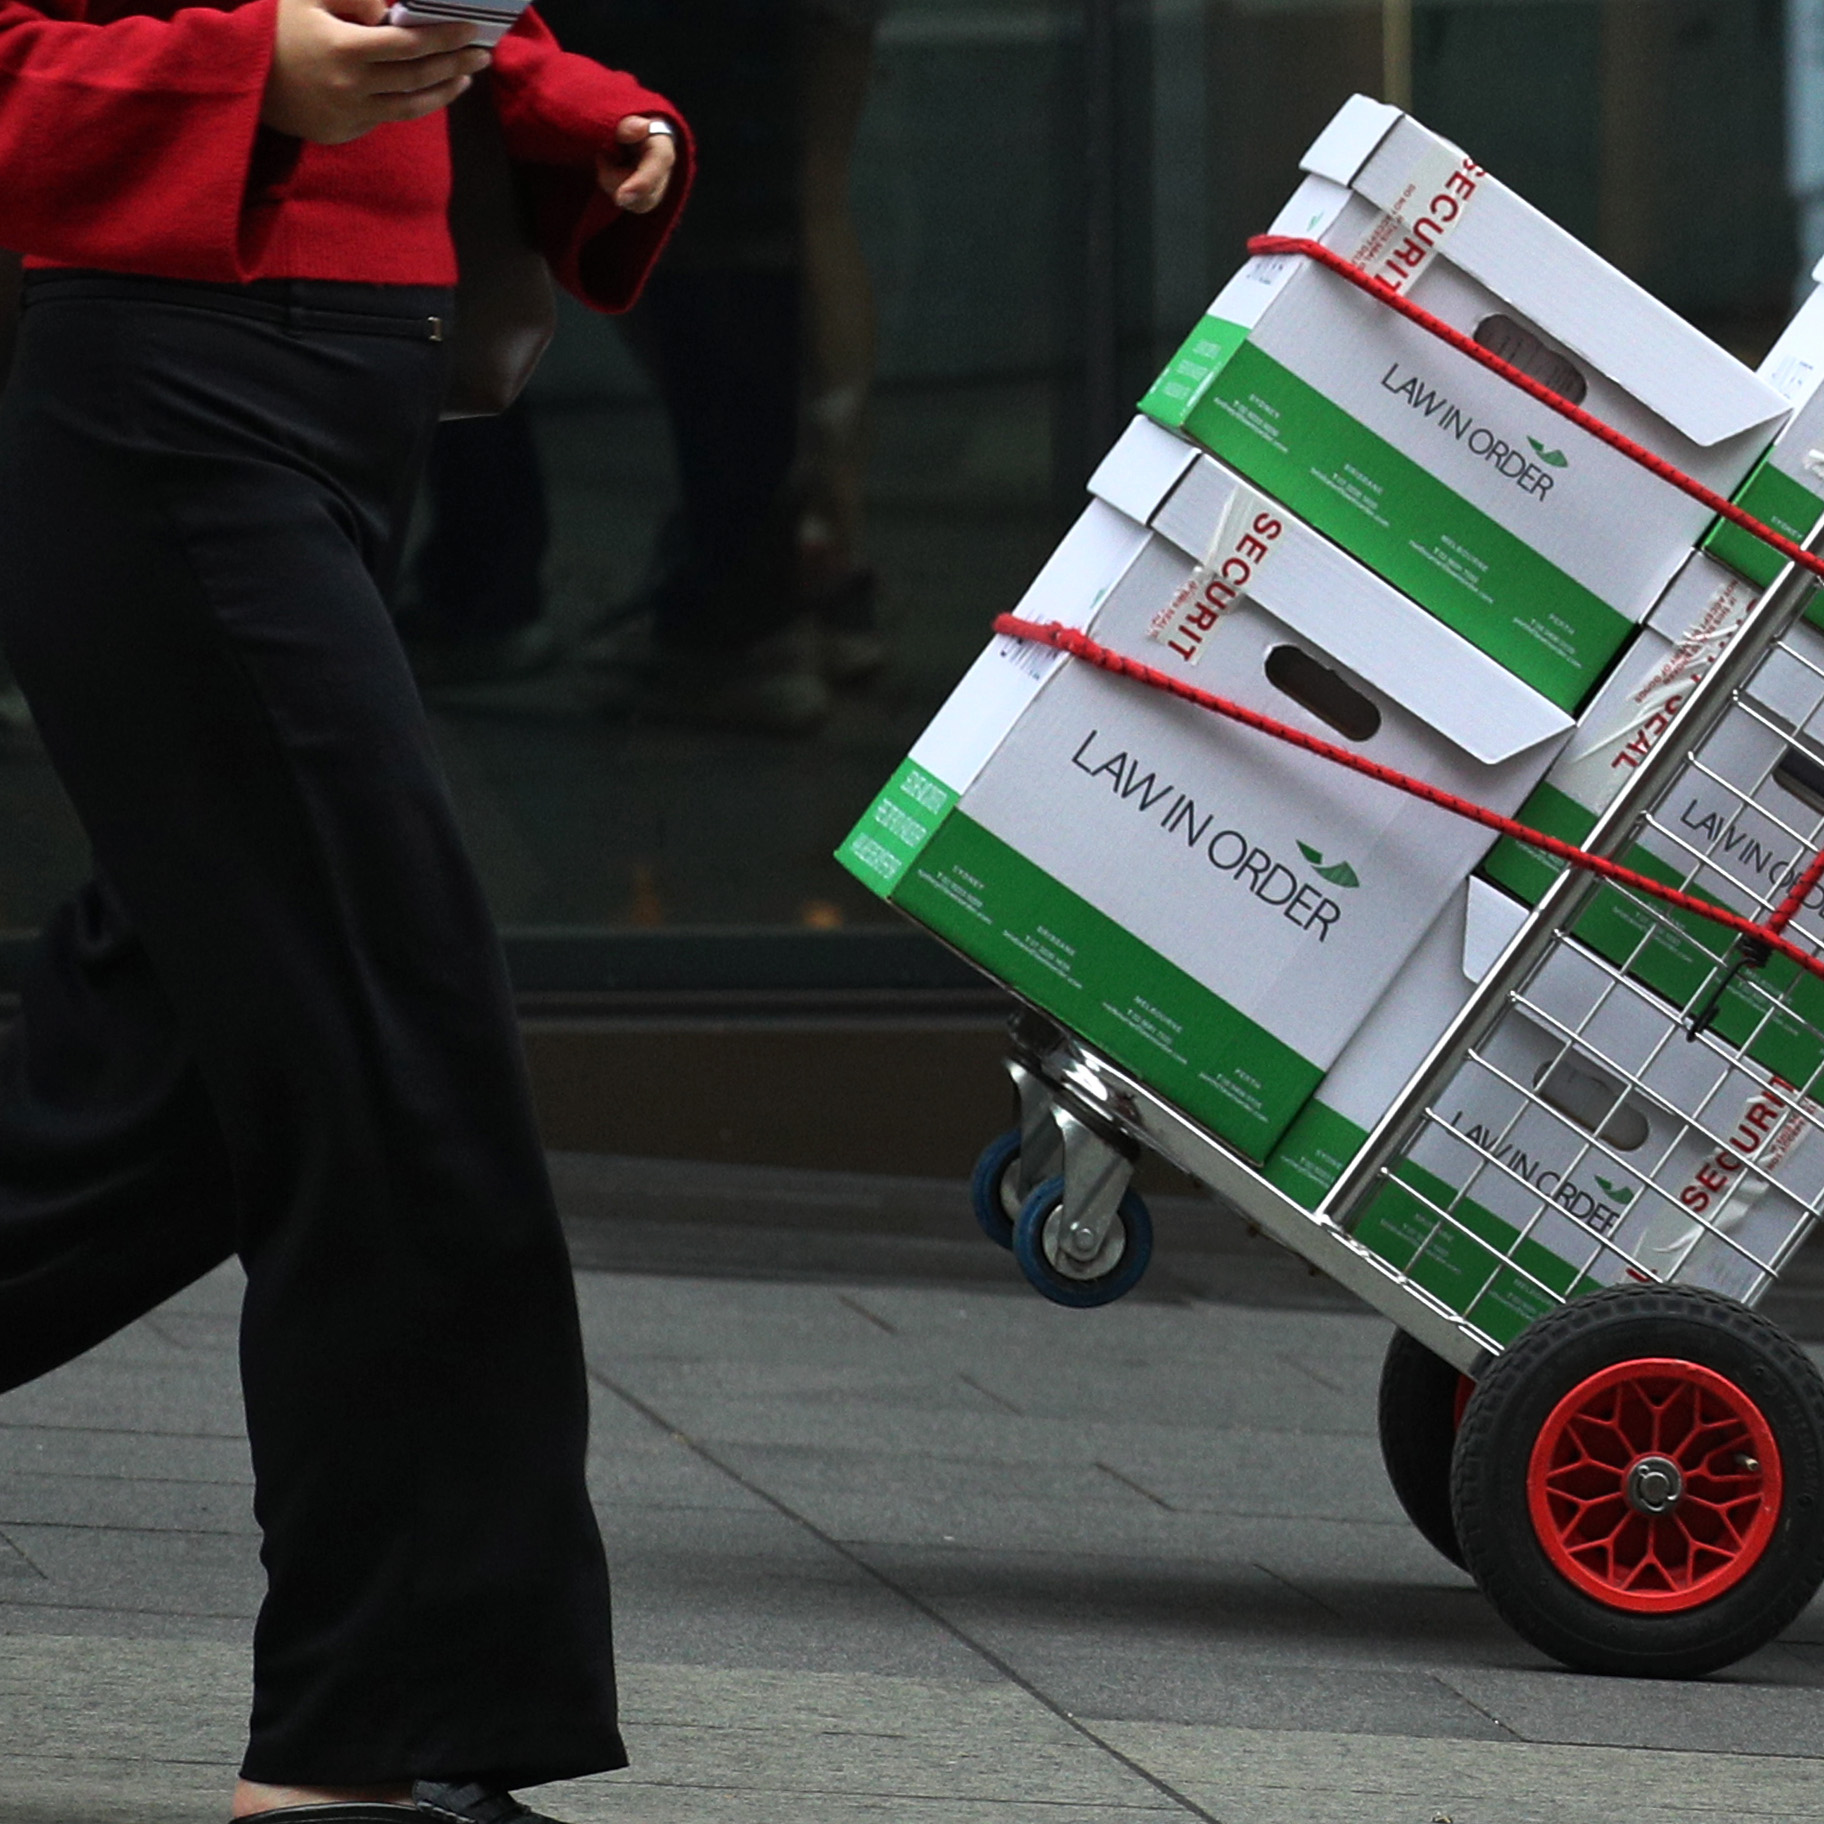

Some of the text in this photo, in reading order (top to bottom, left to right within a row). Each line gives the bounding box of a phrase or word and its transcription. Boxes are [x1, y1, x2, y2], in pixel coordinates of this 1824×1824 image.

[1381, 362, 1554, 502] LAW IN ORDER
[1168, 512, 1283, 663] SECURIT
[1072, 730, 1341, 943] LAW IN ORDER
[1682, 800, 1744, 853] LAW
[1740, 841, 1771, 871] IN
